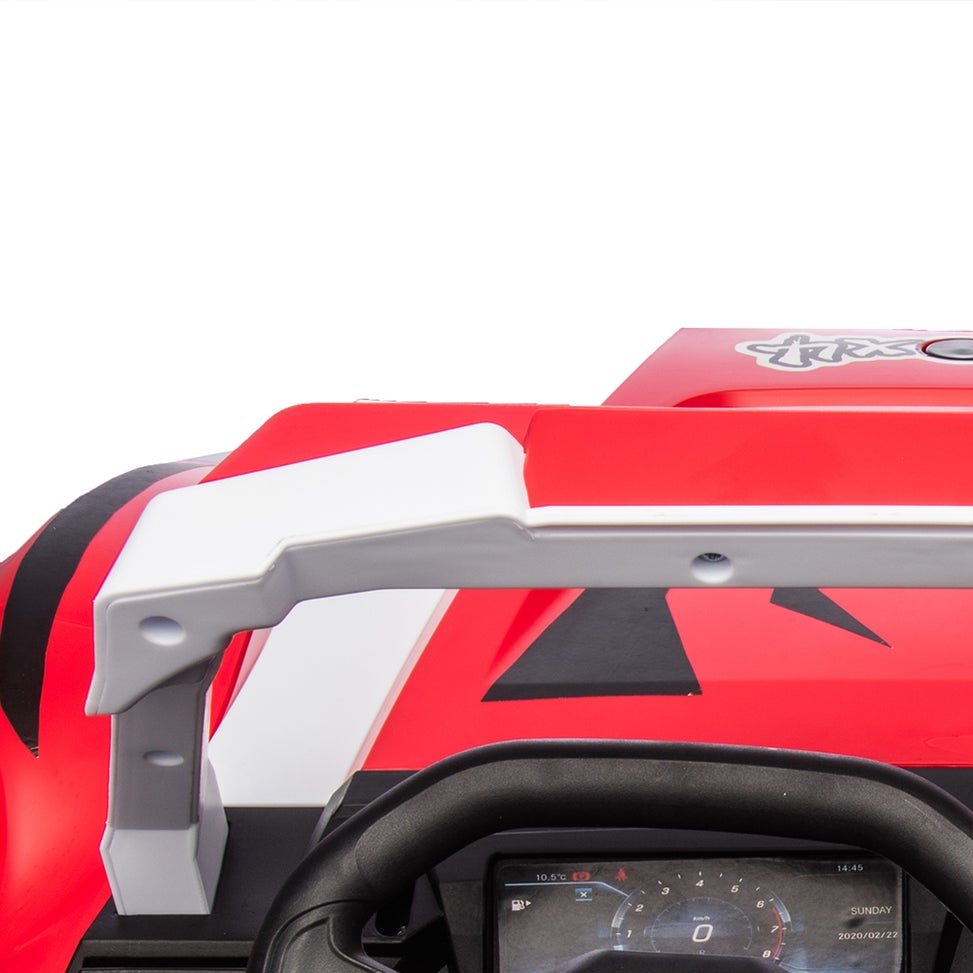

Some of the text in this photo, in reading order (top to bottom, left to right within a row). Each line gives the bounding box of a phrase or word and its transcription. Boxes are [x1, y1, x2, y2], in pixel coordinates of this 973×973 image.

[837, 864, 864, 872] 14:45
[661, 887, 670, 895] 3
[730, 885, 739, 893] 5
[635, 904, 644, 912] 2
[756, 900, 765, 908] 6
[850, 906, 893, 916] SUNDAY
[692, 924, 714, 943] 0
[770, 925, 779, 934] 7
[626, 930, 633, 938] 1
[838, 931, 898, 940] 2020/02/22
[762, 950, 771, 958] 8
